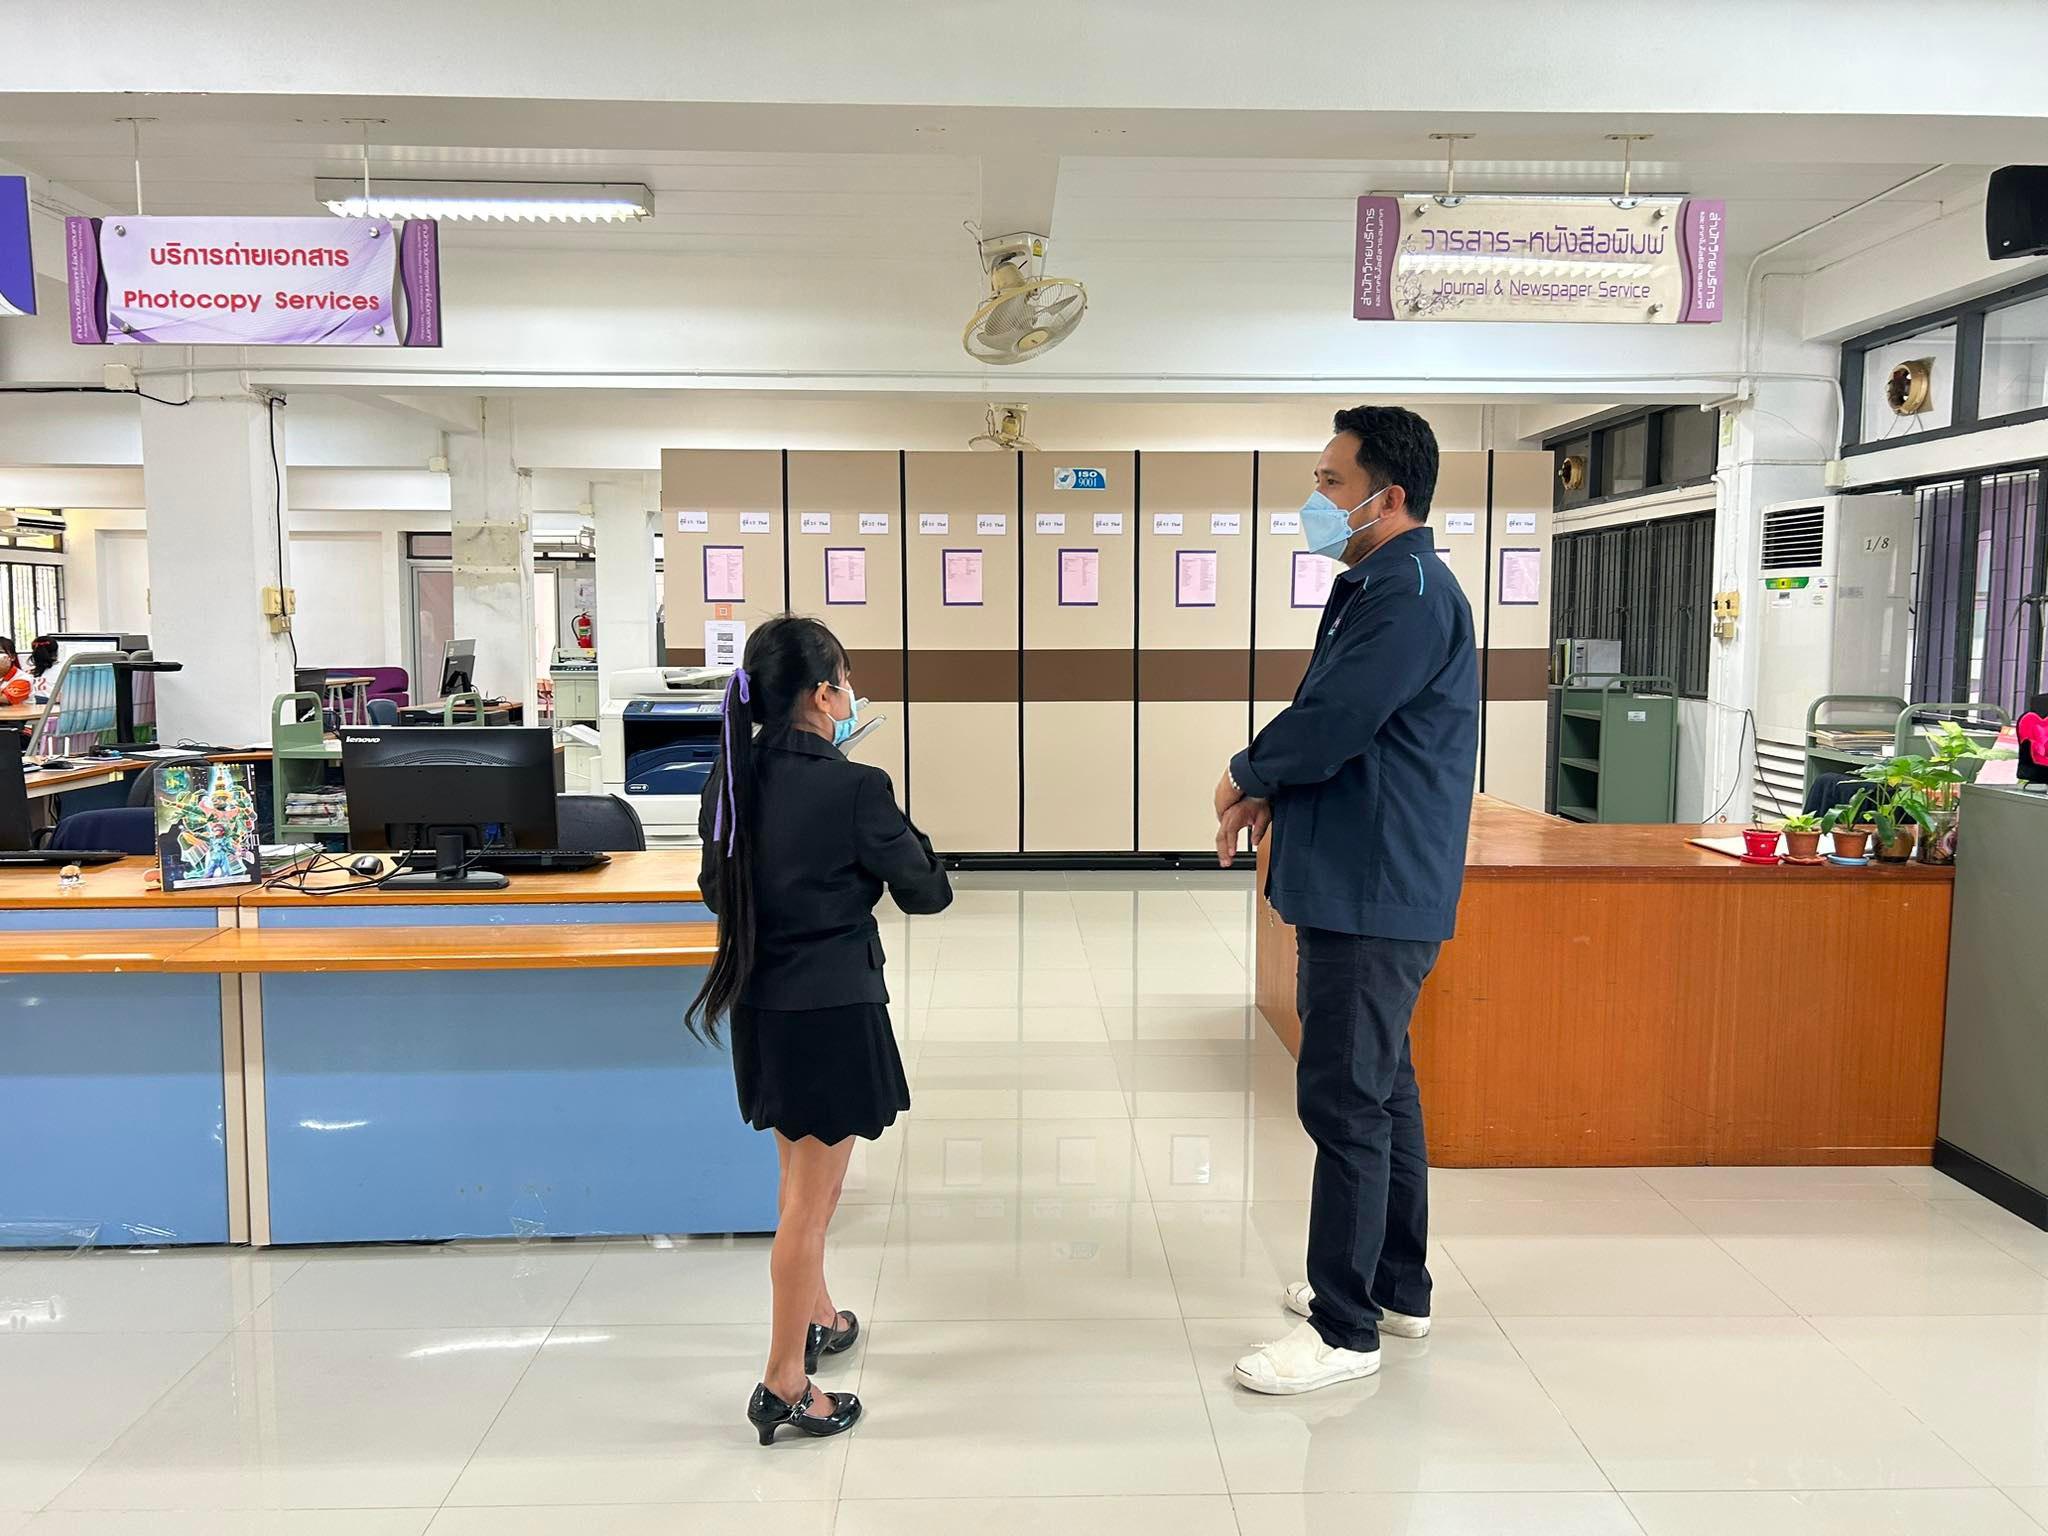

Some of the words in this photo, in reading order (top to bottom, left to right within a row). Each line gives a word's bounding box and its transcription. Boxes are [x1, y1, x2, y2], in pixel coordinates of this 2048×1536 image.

[1421, 225, 1668, 254] วารสาร-หนังสือพิมพ์
[150, 241, 349, 267] บริการถ่ายเอกสาร
[1433, 278, 1487, 295] Journal
[1494, 279, 1504, 295] &
[1510, 279, 1592, 301] Newspaper
[1598, 281, 1650, 298] Service
[124, 290, 261, 312] Photocopy
[275, 291, 379, 311] Services
[1078, 478, 1097, 487] 9001
[1866, 536, 1890, 552] 1/8
[346, 735, 380, 743] lenovo
